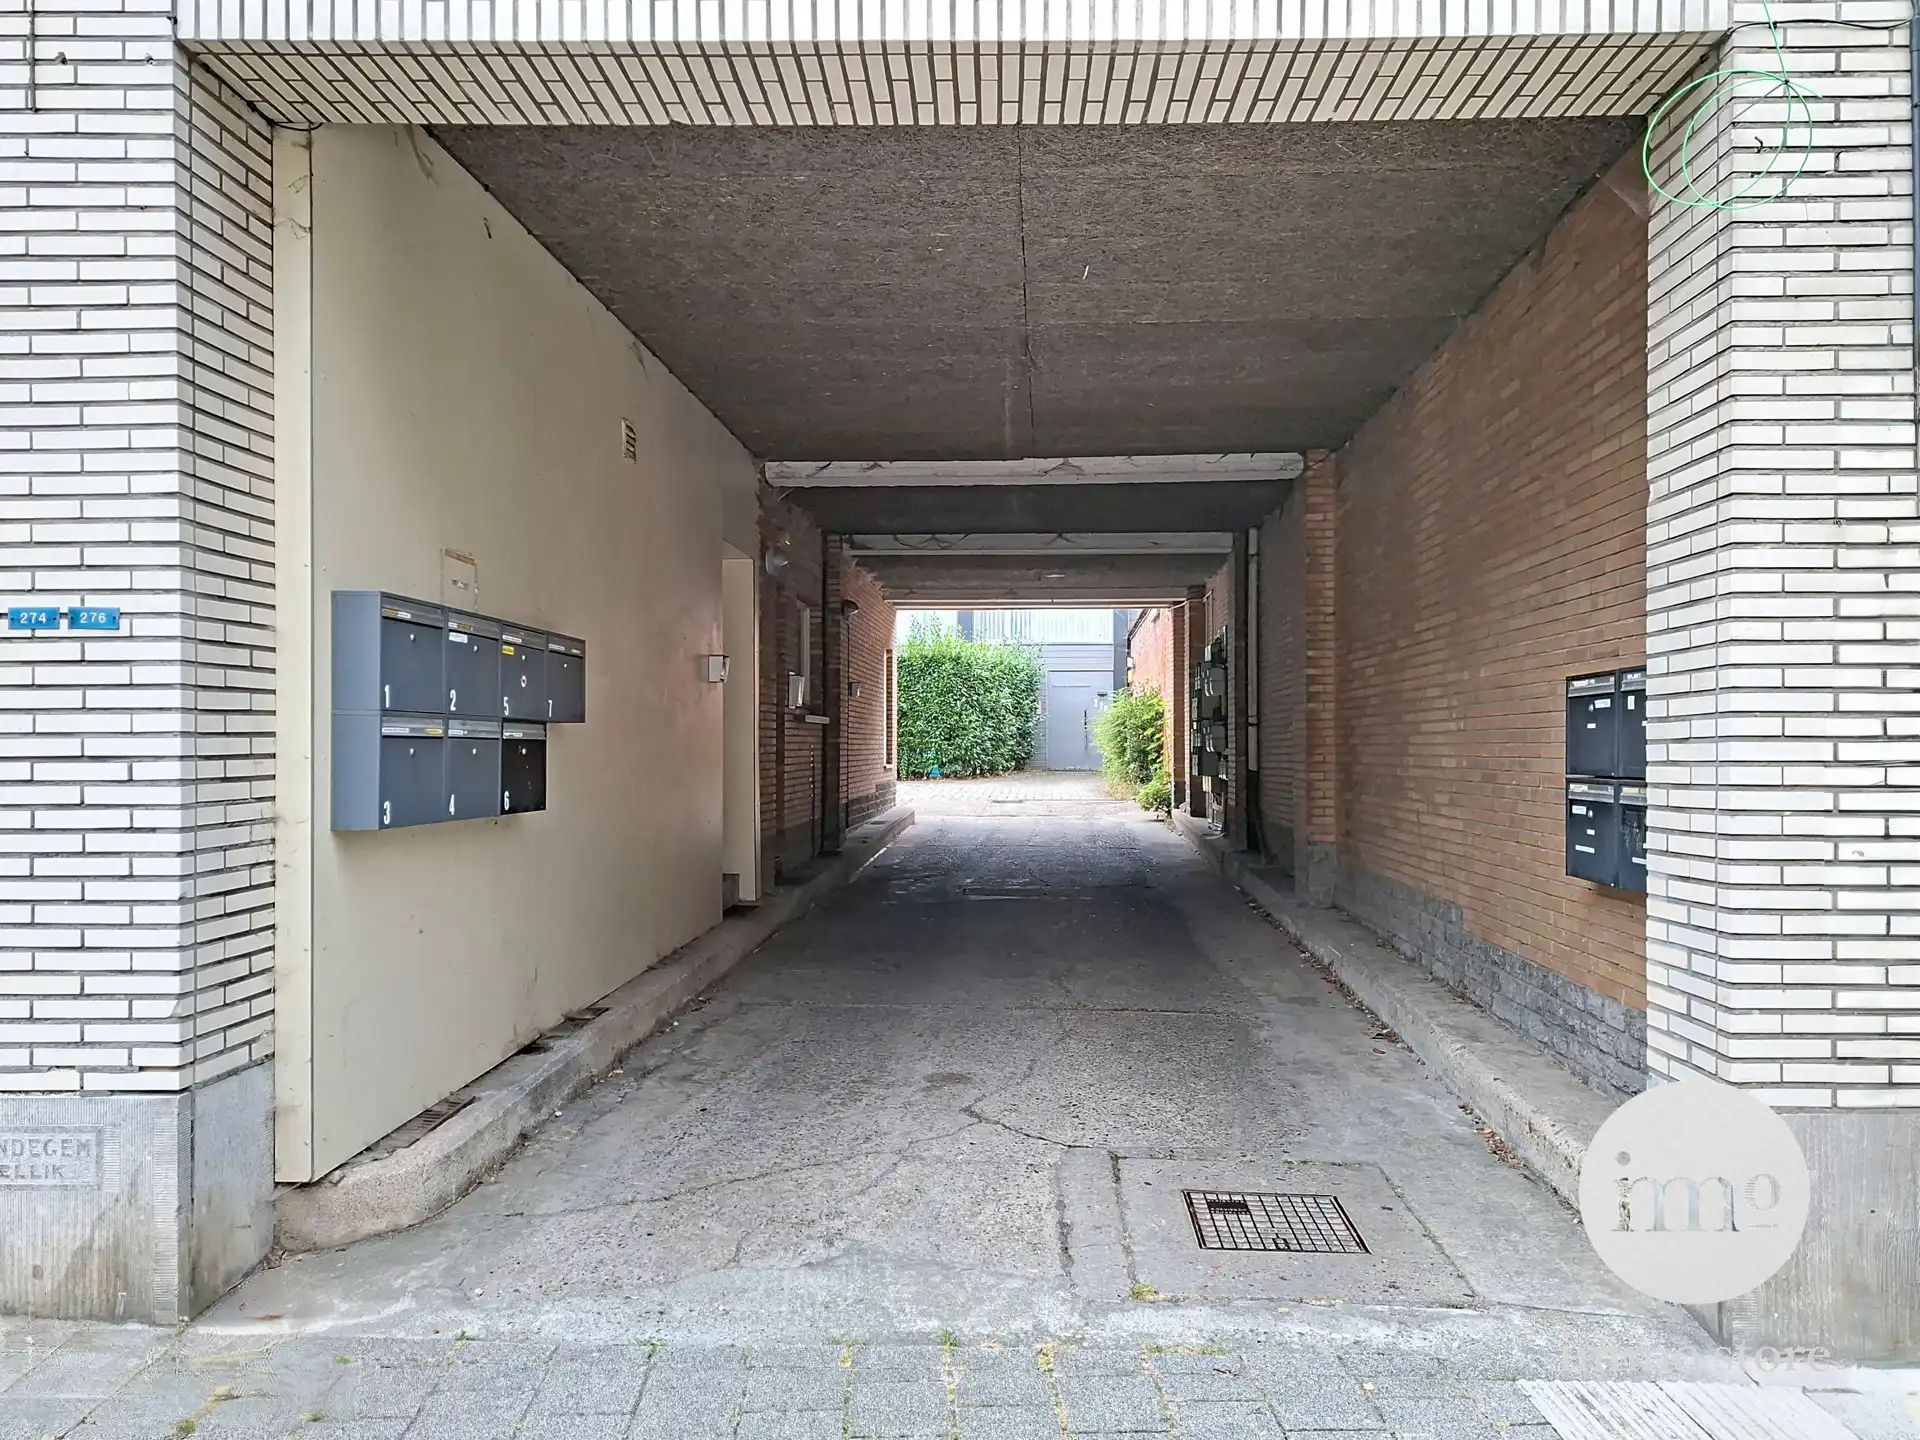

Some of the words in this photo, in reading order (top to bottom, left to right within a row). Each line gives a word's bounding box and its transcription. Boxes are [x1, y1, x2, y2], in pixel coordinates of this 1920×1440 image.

[20, 612, 47, 624] 274
[80, 612, 107, 624] 276
[384, 684, 391, 709] 1
[450, 689, 457, 711] 2
[503, 696, 510, 716] 5
[548, 700, 553, 718] 7
[449, 794, 456, 816] 4
[504, 790, 510, 811] 6
[383, 800, 391, 825] 3
